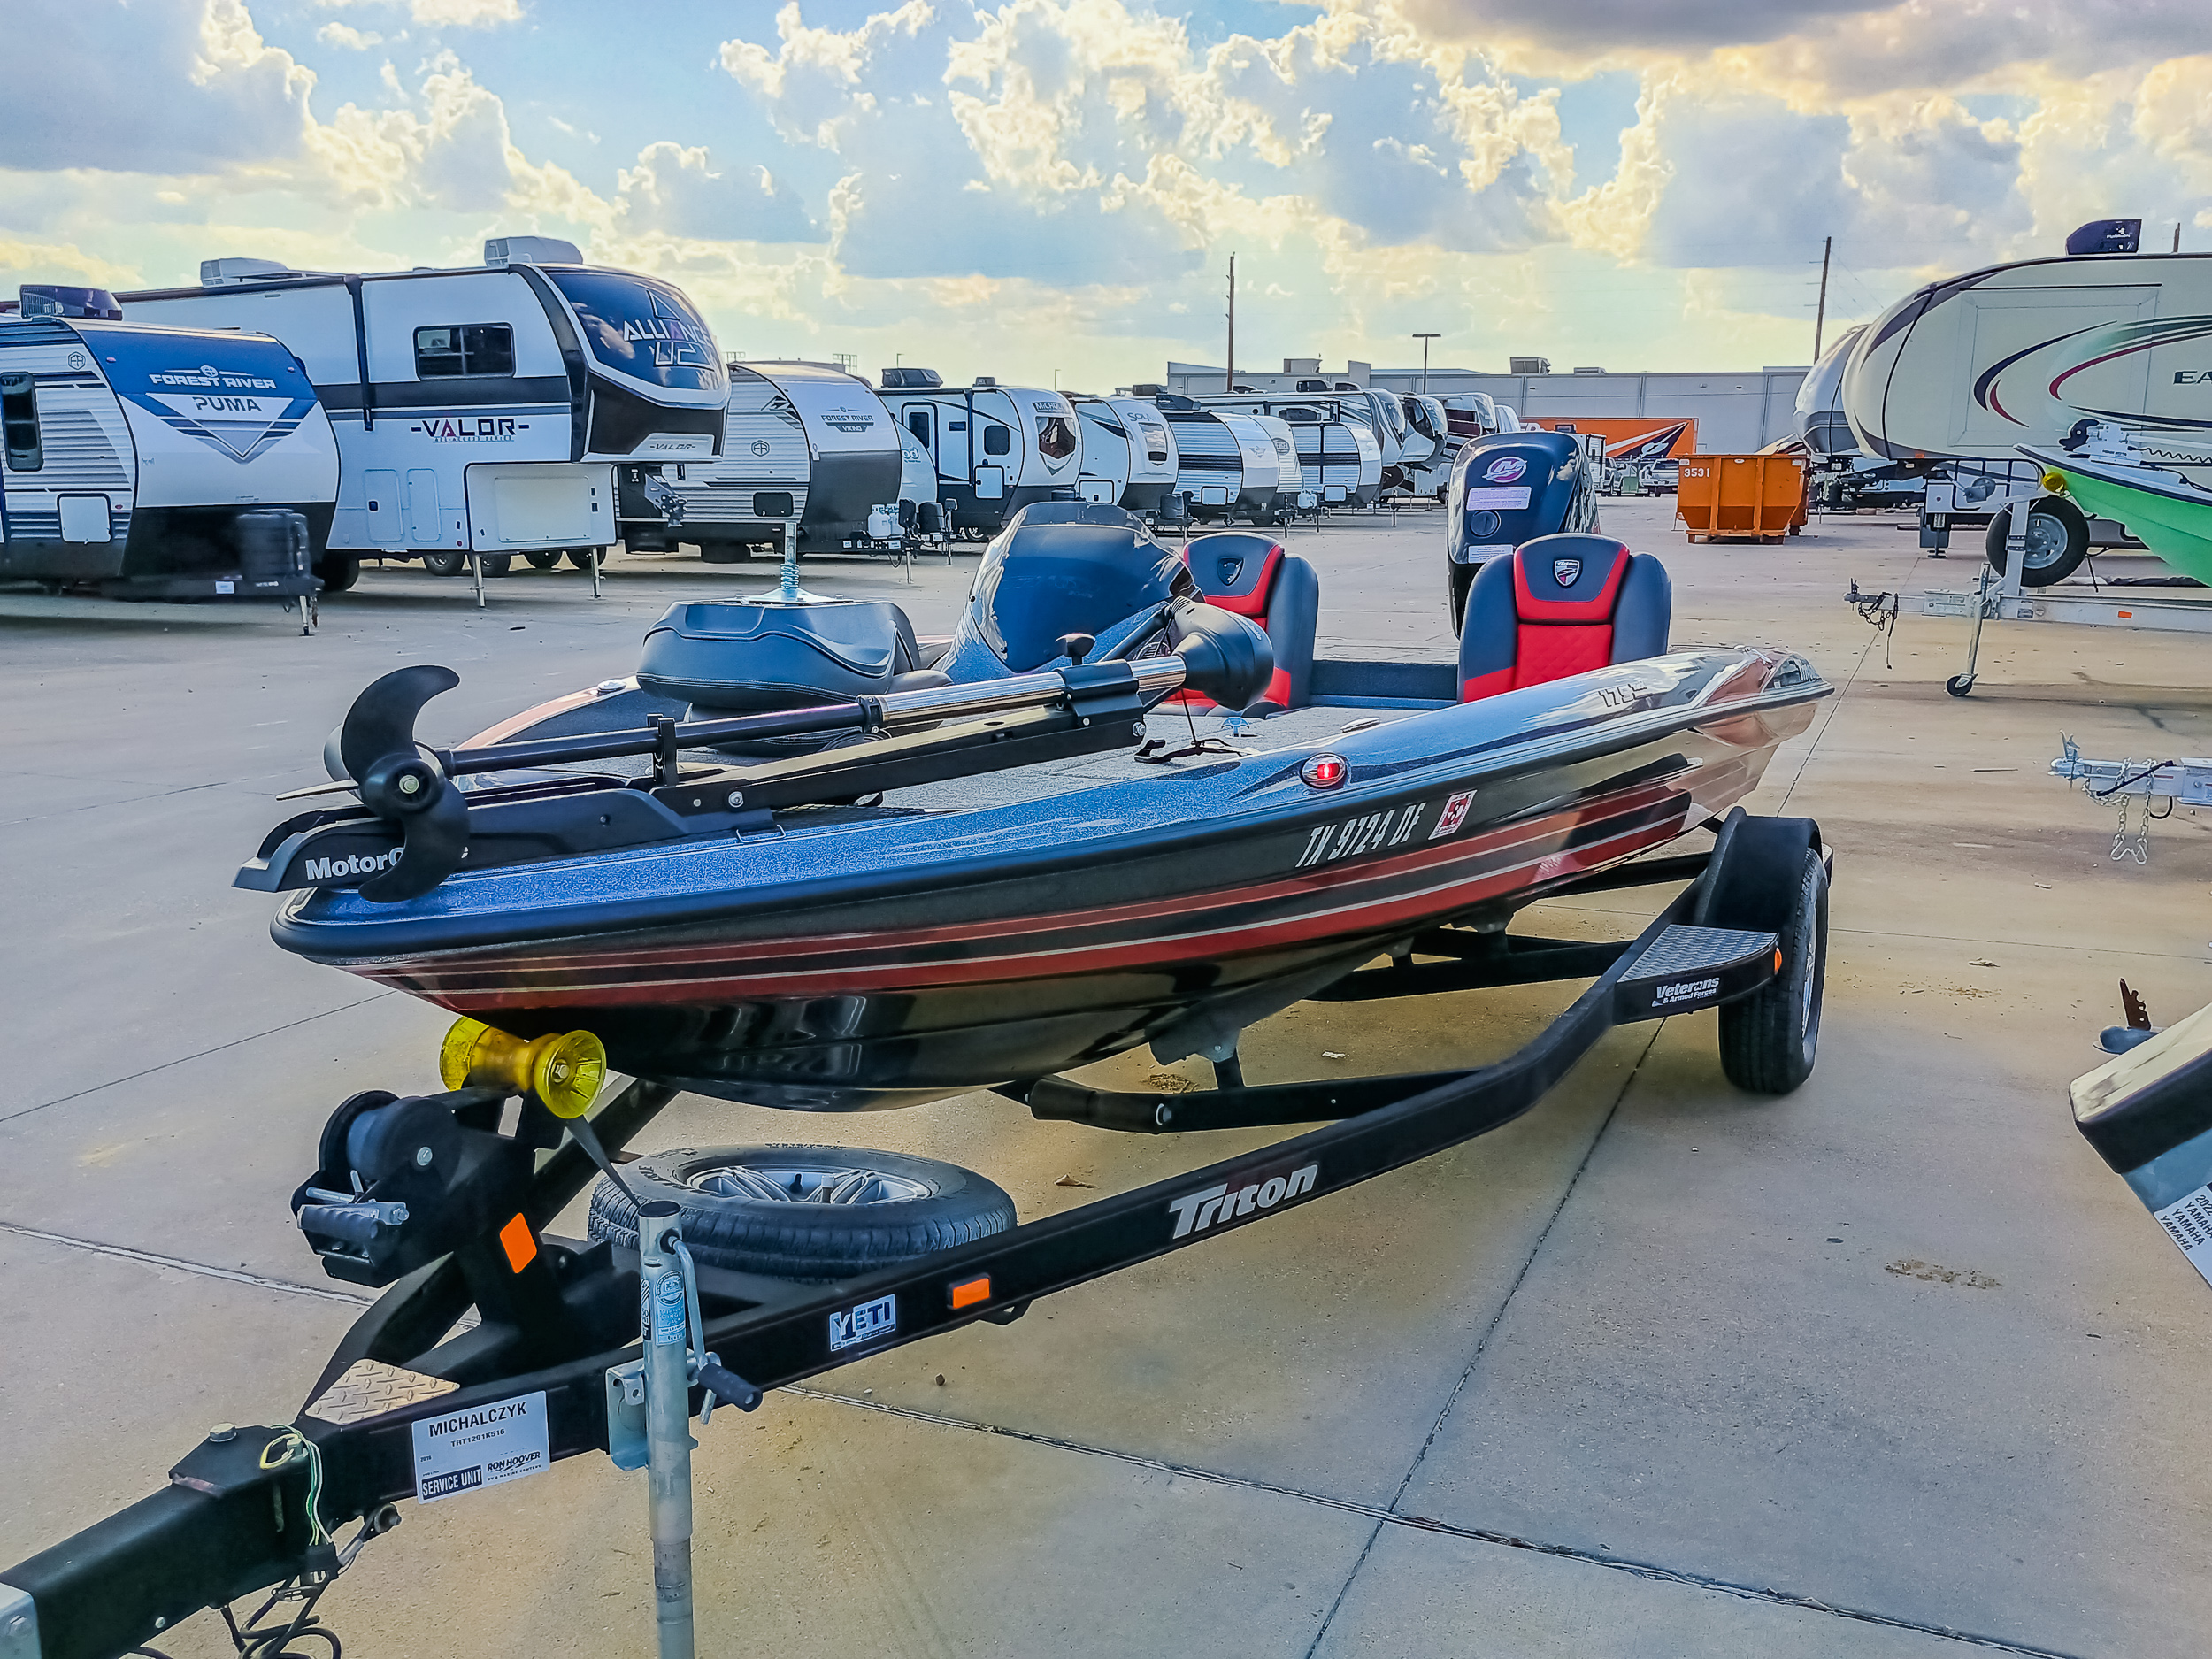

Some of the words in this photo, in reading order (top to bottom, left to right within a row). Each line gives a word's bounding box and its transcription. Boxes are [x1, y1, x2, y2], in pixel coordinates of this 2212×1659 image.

[149, 374, 220, 387] FOREST
[222, 377, 276, 389] RIVER
[192, 396, 262, 412] PUMA
[1684, 467, 1709, 478] 3531
[1295, 825, 1338, 868] TX
[1328, 809, 1396, 861] 9724
[1387, 802, 1427, 847] DE
[305, 847, 405, 881] Motor
[1656, 977, 1720, 999] Veterans
[1169, 1164, 1318, 1239] Triton
[2160, 1215, 2193, 1251] YAMAHA
[2171, 1208, 2206, 1246] YAMAHA
[833, 1301, 891, 1340] YETI
[429, 1402, 526, 1438] MICHALCZYK
[487, 1461, 505, 1472] RON
[506, 1451, 541, 1466] HOOVER
[422, 1473, 459, 1497] SERVICE
[461, 1468, 482, 1486] UNIT
